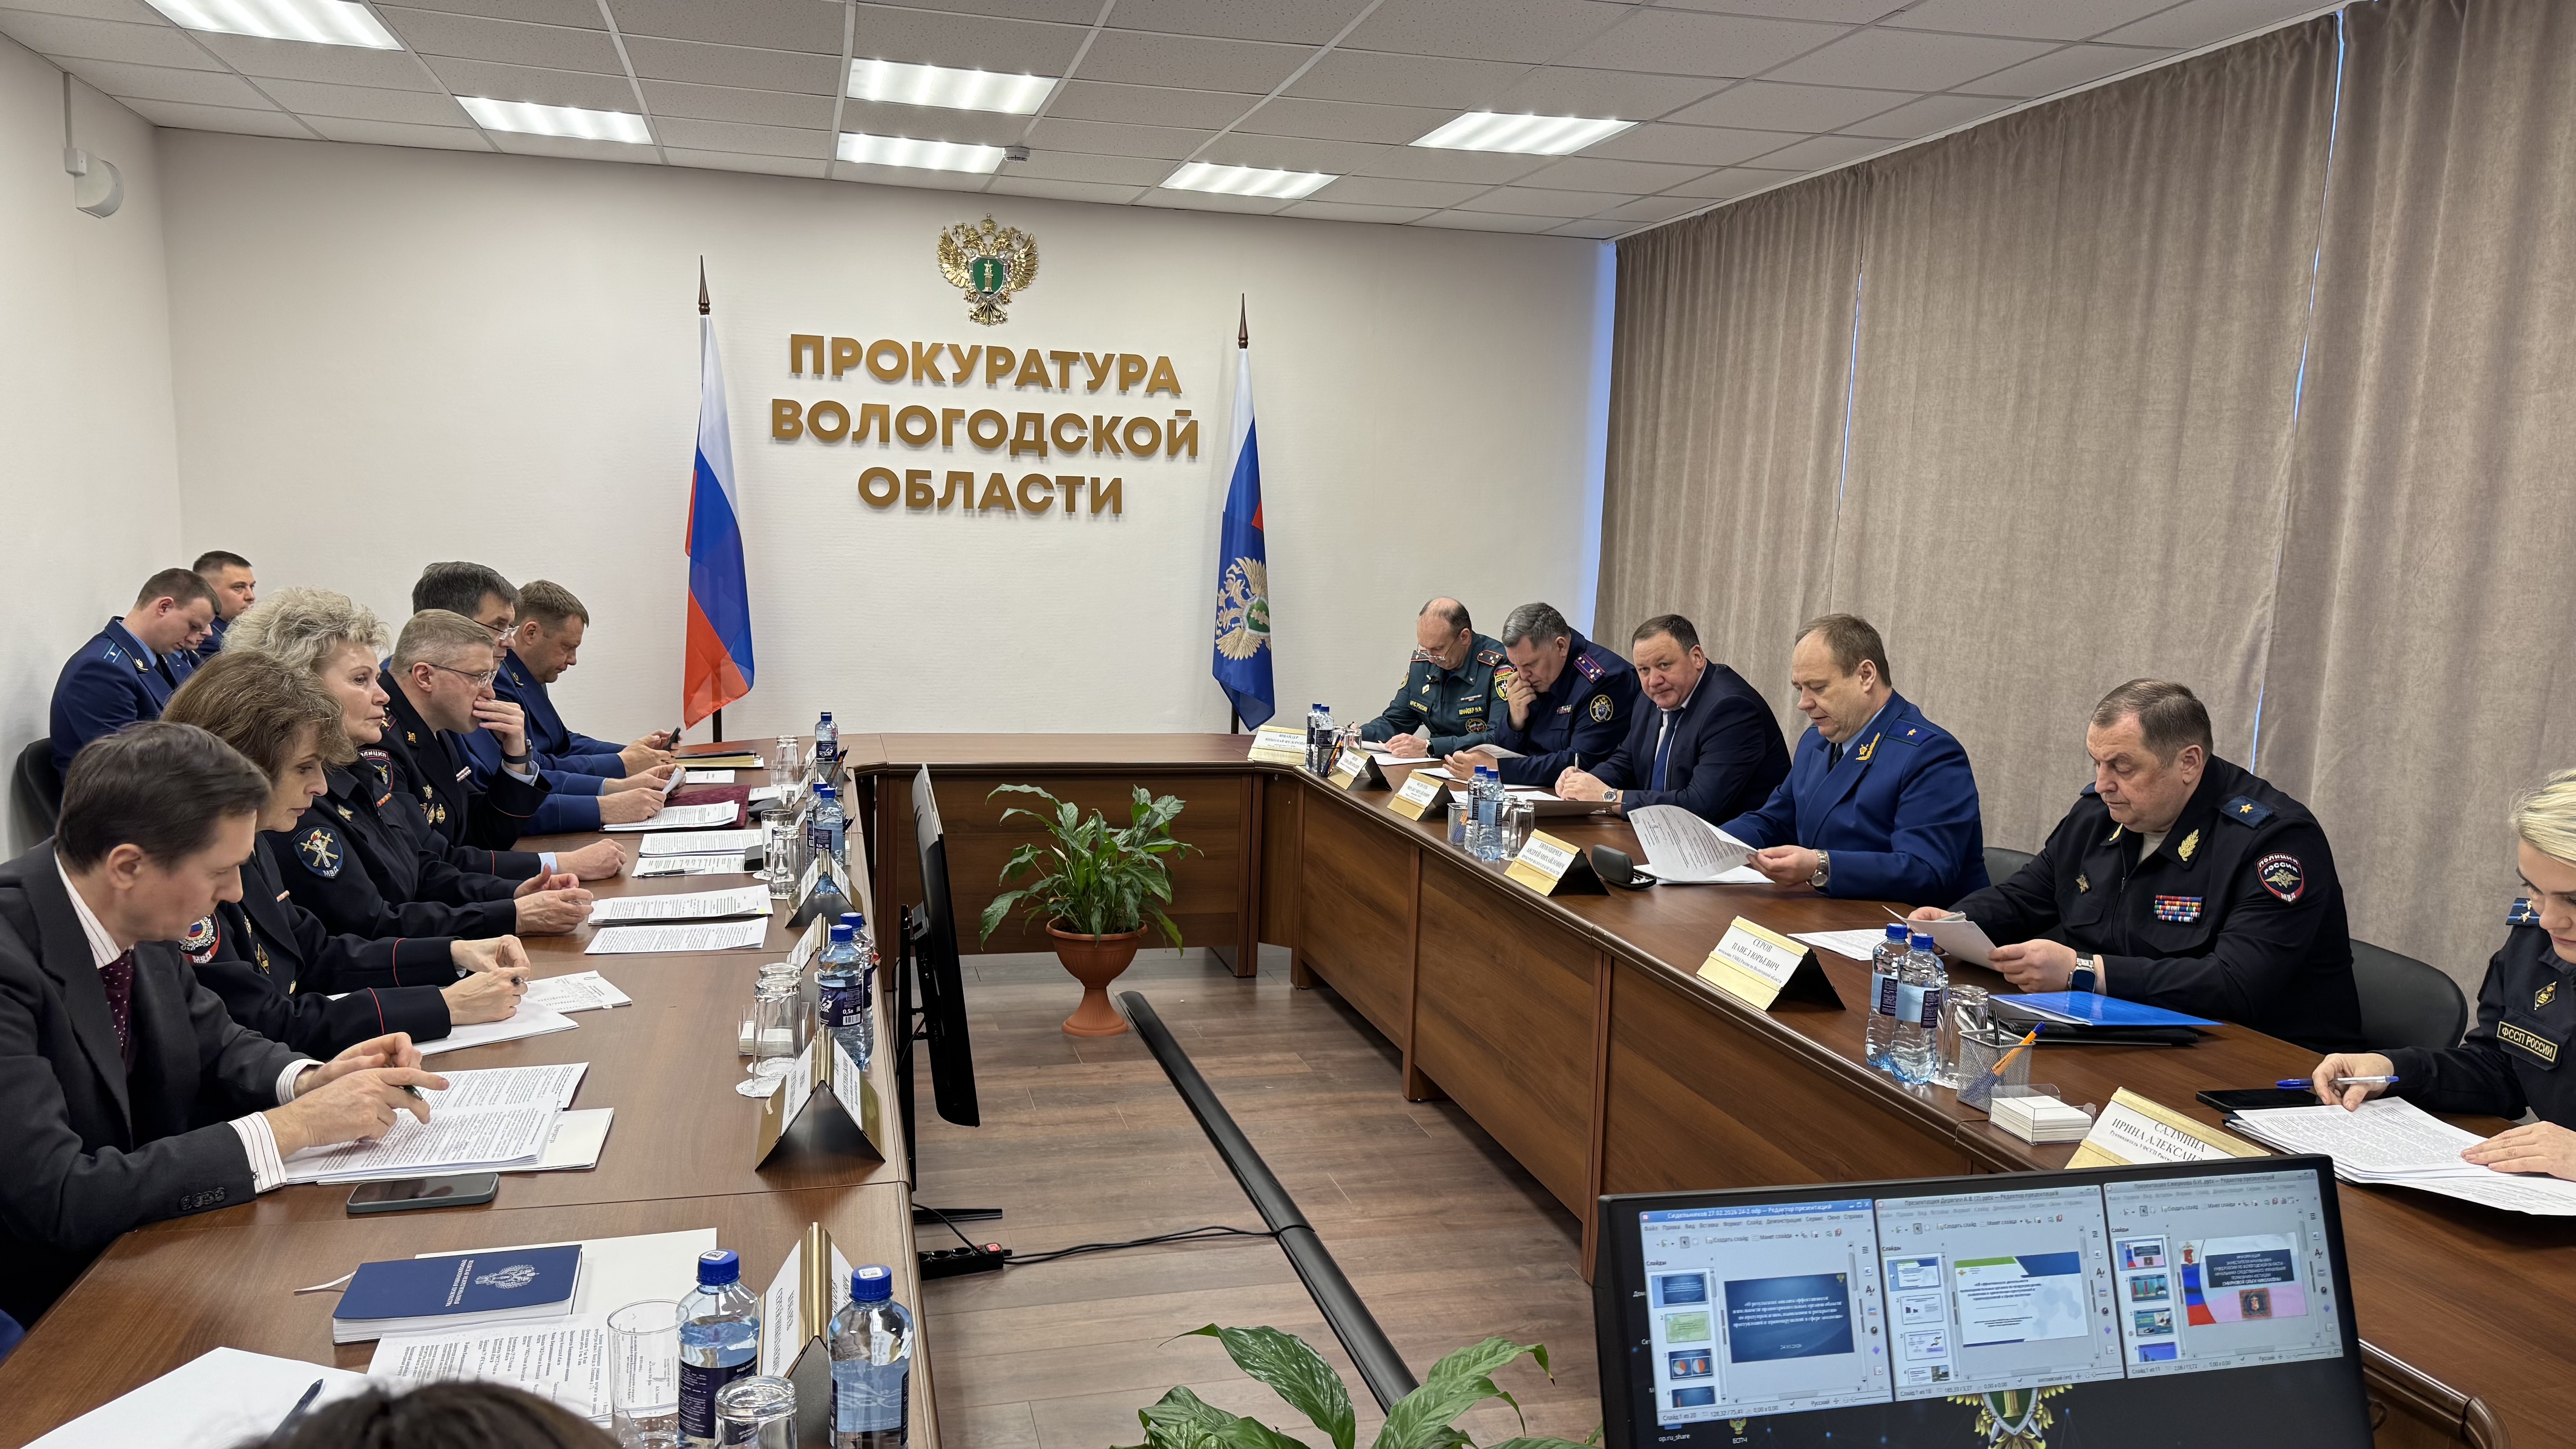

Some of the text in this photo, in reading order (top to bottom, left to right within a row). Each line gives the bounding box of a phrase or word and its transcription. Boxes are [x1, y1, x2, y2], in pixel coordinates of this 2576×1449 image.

[790, 333, 1183, 395] ПРОКУРАТУРА
[772, 398, 1198, 458] ВОЛОГОДСКОЙ
[858, 467, 1122, 514] ОБЛАСТИ
[323, 865, 339, 877] МВД
[2259, 854, 2298, 868] ПОЛИЦИЯ
[2264, 862, 2298, 875] РОССИЯ
[2280, 892, 2296, 902] МВД
[1732, 943, 1780, 971] ПАВЕЛ ЮРЬЕВИЧ
[1753, 938, 1773, 952] СЕРОВ
[2502, 1027, 2553, 1057] ФССП РОССИИ
[2112, 1118, 2206, 1161] ИРИНА АЛЕКСАН
[2155, 1122, 2205, 1152] САЛМИНА
[1658, 1434, 1690, 1442] op.ru_share
